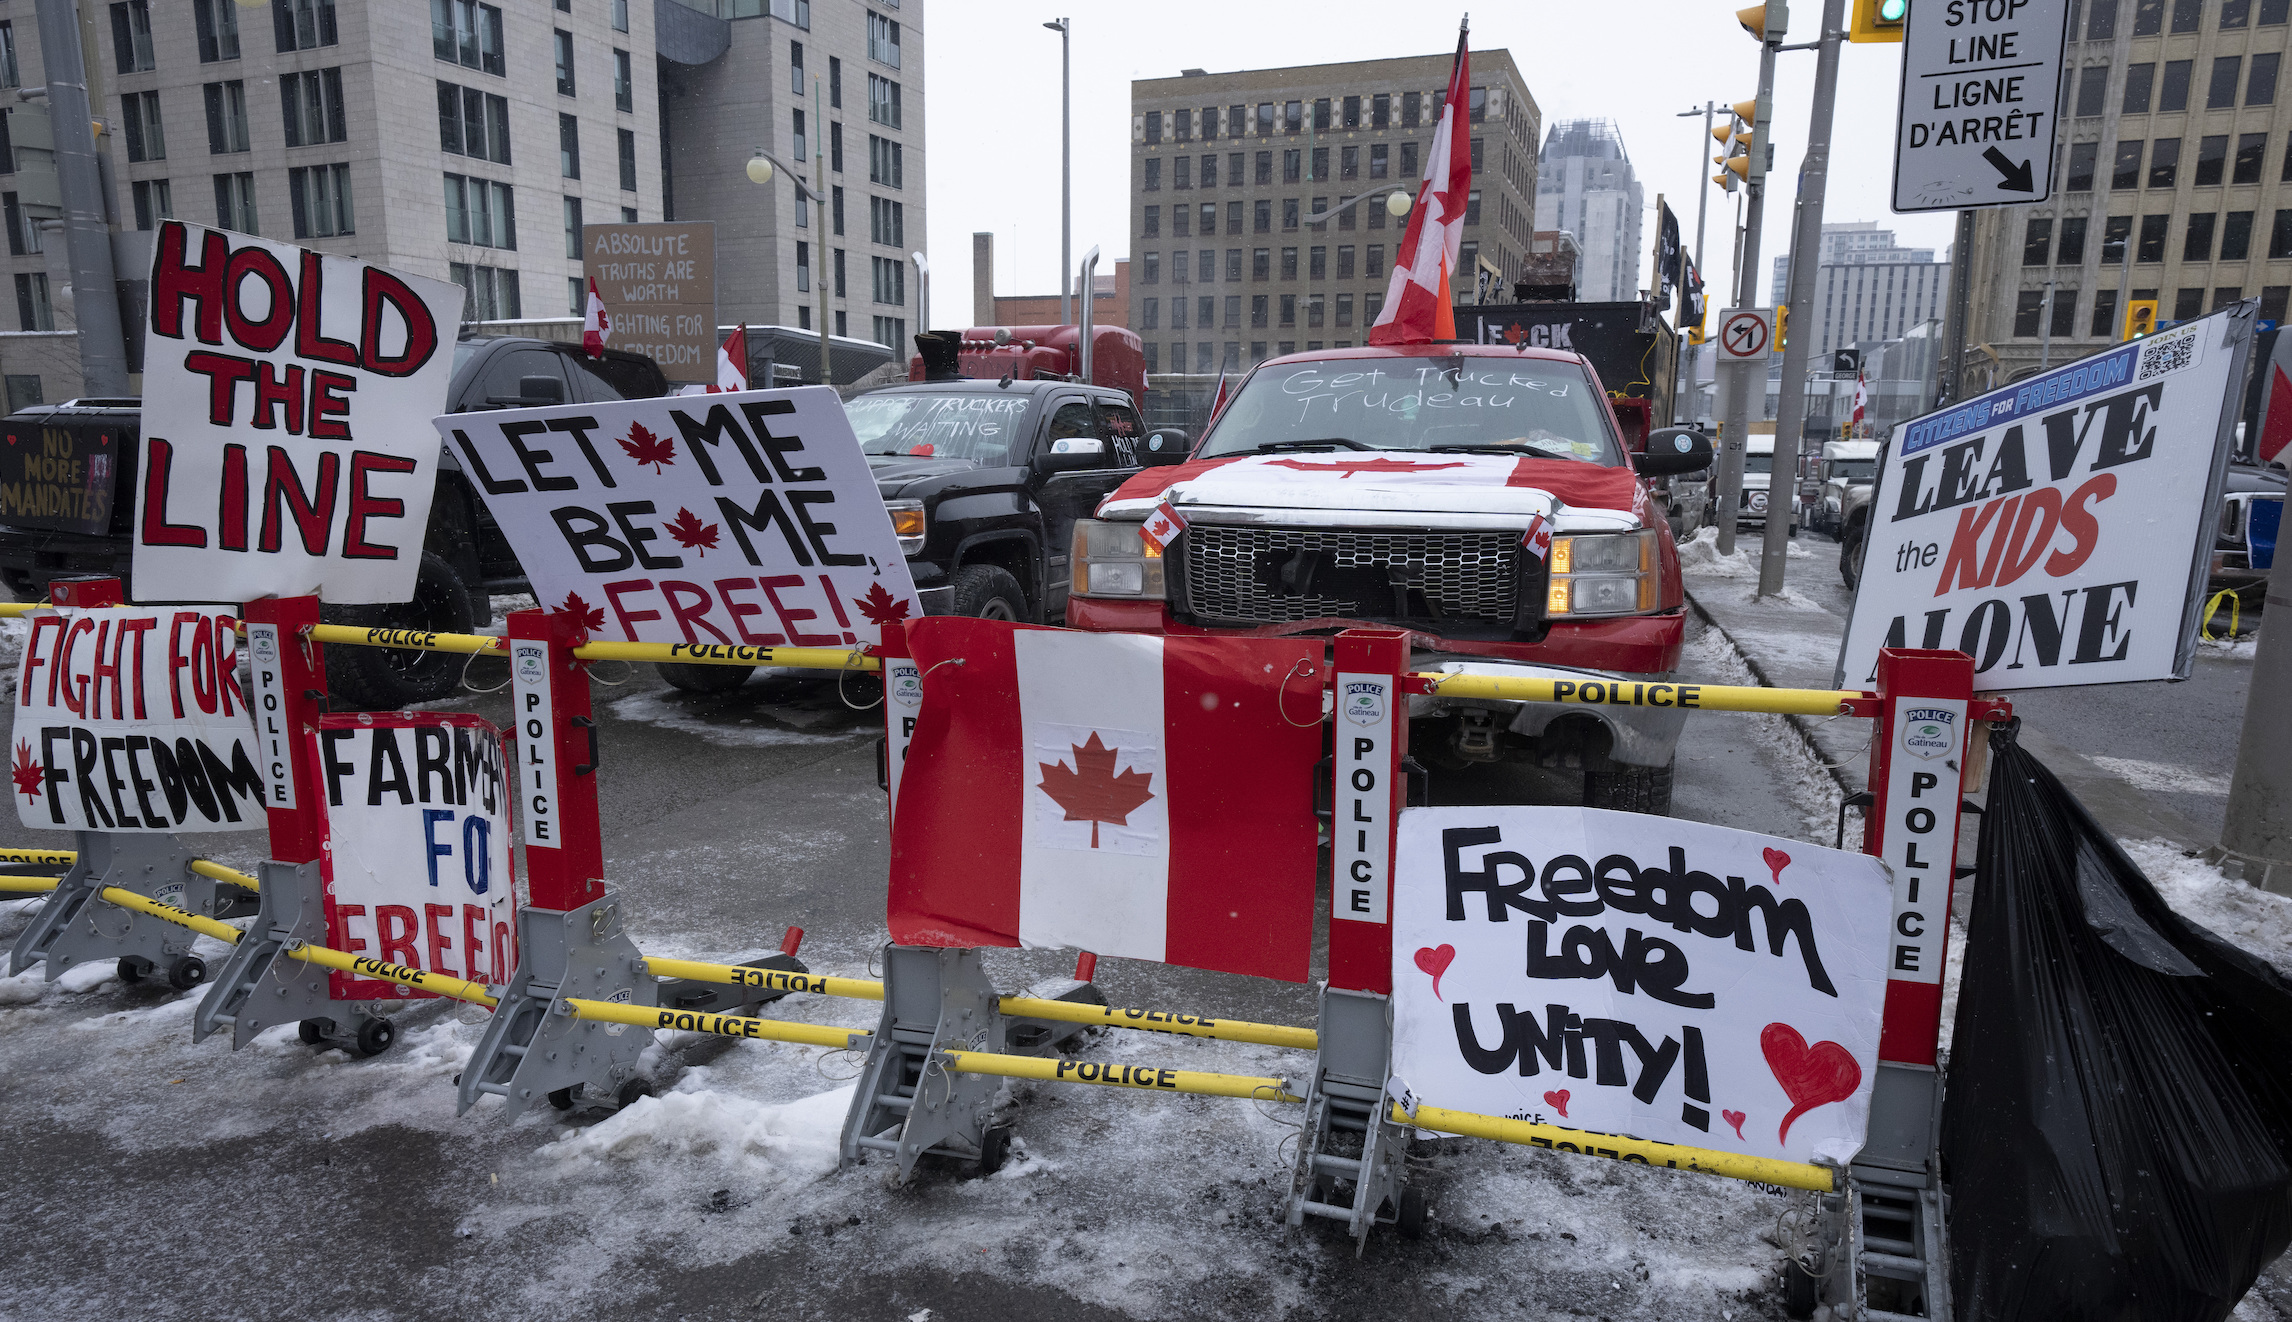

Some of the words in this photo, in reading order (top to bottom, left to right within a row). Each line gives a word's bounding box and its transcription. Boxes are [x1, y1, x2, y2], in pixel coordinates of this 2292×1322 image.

[1945, 0, 2029, 26] STOP
[1949, 32, 2019, 64] LINE
[1934, 76, 2025, 109] LIGNE
[1910, 108, 2044, 148] D'ARRÊT
[594, 233, 689, 256] ABSOLUTE
[598, 262, 655, 281] TRUTHS
[664, 260, 696, 280] ARE
[152, 221, 438, 377] HOLD
[622, 284, 679, 302] WORTH
[609, 313, 670, 338] IGHTING
[676, 314, 703, 336] FOR
[2147, 331, 2178, 346] JOIN
[2181, 325, 2198, 336] US
[185, 350, 356, 440] THE
[1906, 404, 1991, 450] CITIZENS
[1991, 398, 2014, 418] FOR
[2014, 353, 2130, 415] FREEDOM
[43, 428, 73, 459] NO
[452, 415, 617, 496] LET
[670, 399, 827, 486] ME
[1891, 381, 2165, 523] LEAVE
[24, 452, 81, 484] MORE
[1, 482, 108, 522] MANDATES
[142, 438, 416, 559] LINE
[550, 500, 684, 573] BE
[714, 489, 881, 576] ME,
[1896, 541, 1939, 572] the
[1934, 472, 2117, 597] KIDS
[603, 575, 857, 647] FREE!
[253, 631, 273, 640] POLICE
[367, 628, 436, 647] POLICE
[21, 614, 157, 720] FIGHT
[169, 612, 247, 719] FOR
[518, 648, 542, 658] POLICE
[671, 643, 773, 661] POLICE
[896, 690, 922, 698] Gatineau
[1348, 684, 1381, 695] POLICE
[1553, 681, 1701, 708] POLICE
[1348, 708, 1379, 717] Gatineau
[1908, 710, 1952, 723] POLICE
[262, 671, 288, 802] POLICE
[1908, 738, 1948, 748] Gatineau
[41, 726, 266, 829] FREEDOM
[526, 693, 549, 840] POLICE
[1350, 738, 1375, 913] POLICE
[422, 808, 491, 896] FO
[1895, 772, 1938, 972] POLICE
[157, 884, 184, 898] POLICE
[351, 955, 429, 985] POLICE
[731, 968, 828, 996] POLICE
[658, 1011, 761, 1038] POLICE
[1056, 1058, 1177, 1089] POLICE
